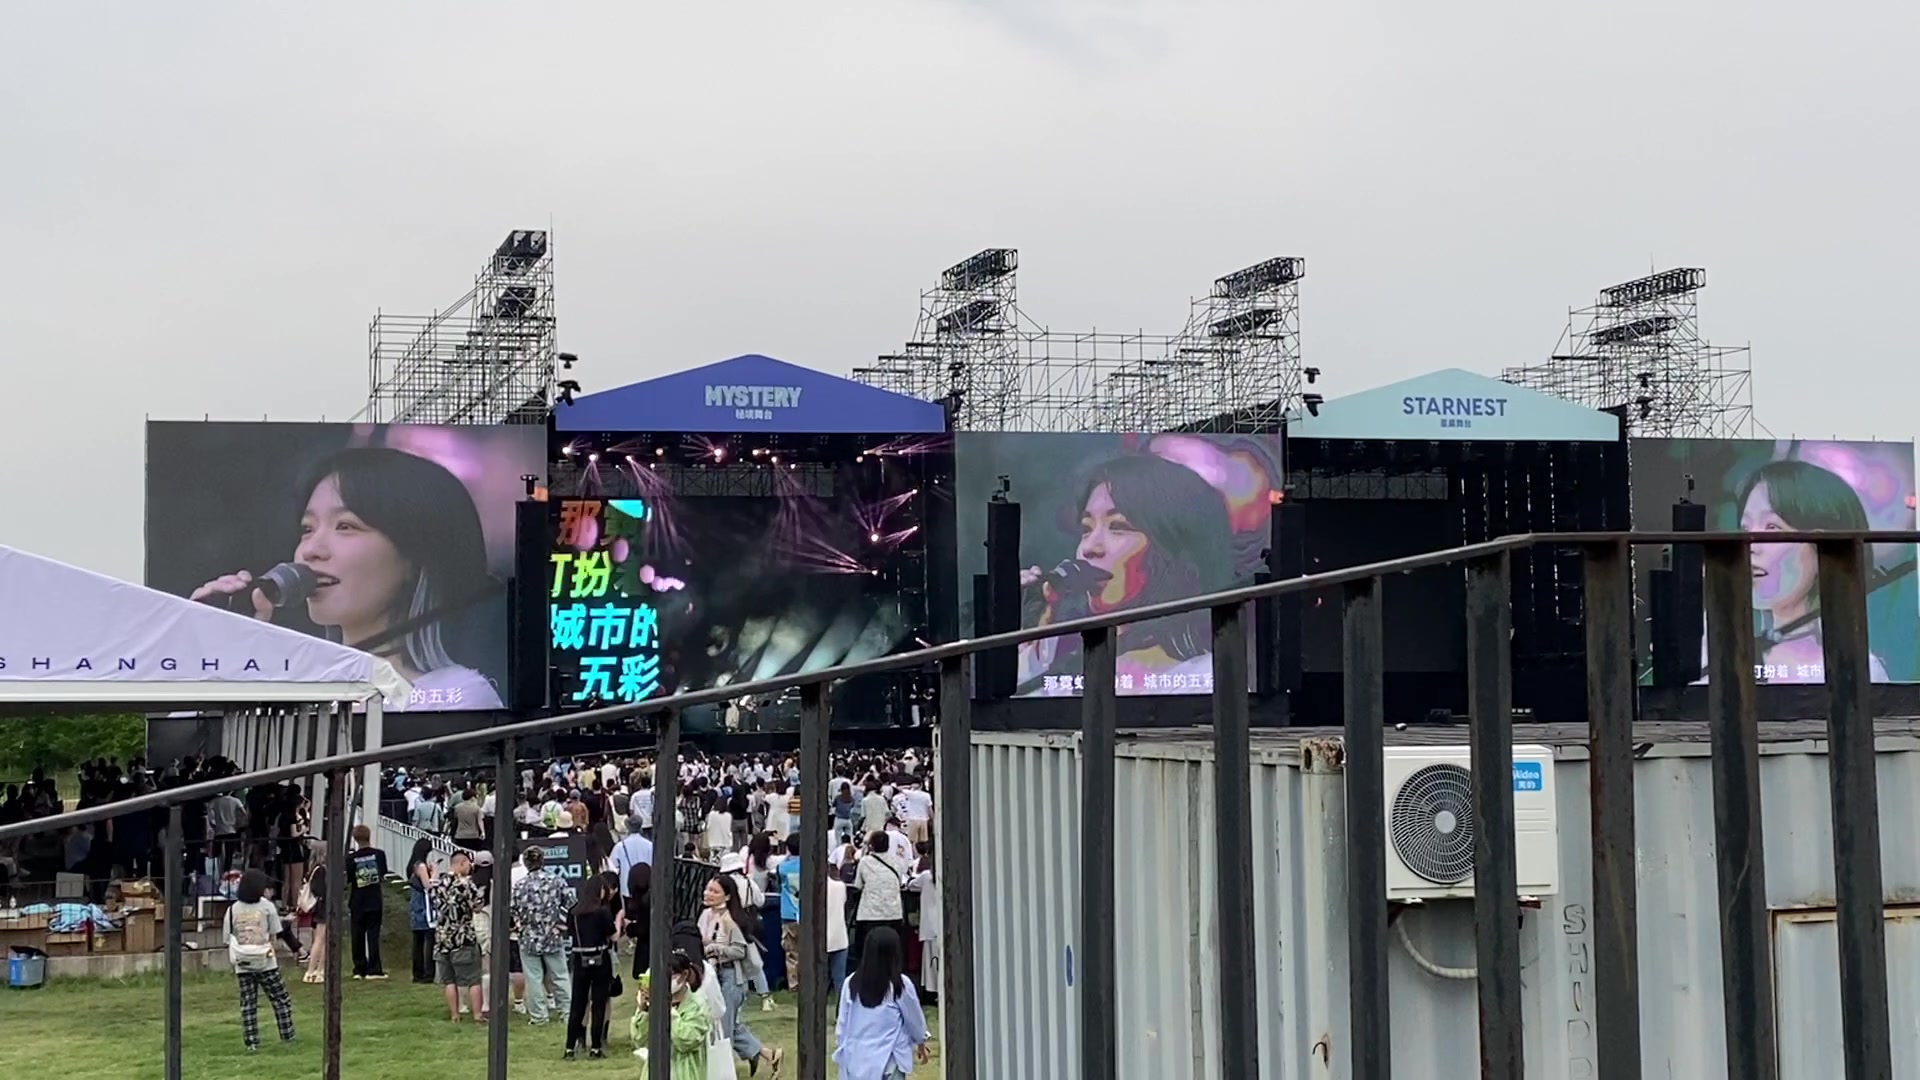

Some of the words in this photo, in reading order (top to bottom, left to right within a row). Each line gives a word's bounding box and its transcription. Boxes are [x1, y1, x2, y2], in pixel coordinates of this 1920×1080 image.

[705, 385, 802, 408] MYSTERY
[1403, 396, 1508, 417] STARNEST
[551, 602, 659, 650] 城市的
[572, 654, 660, 702] 五彩
